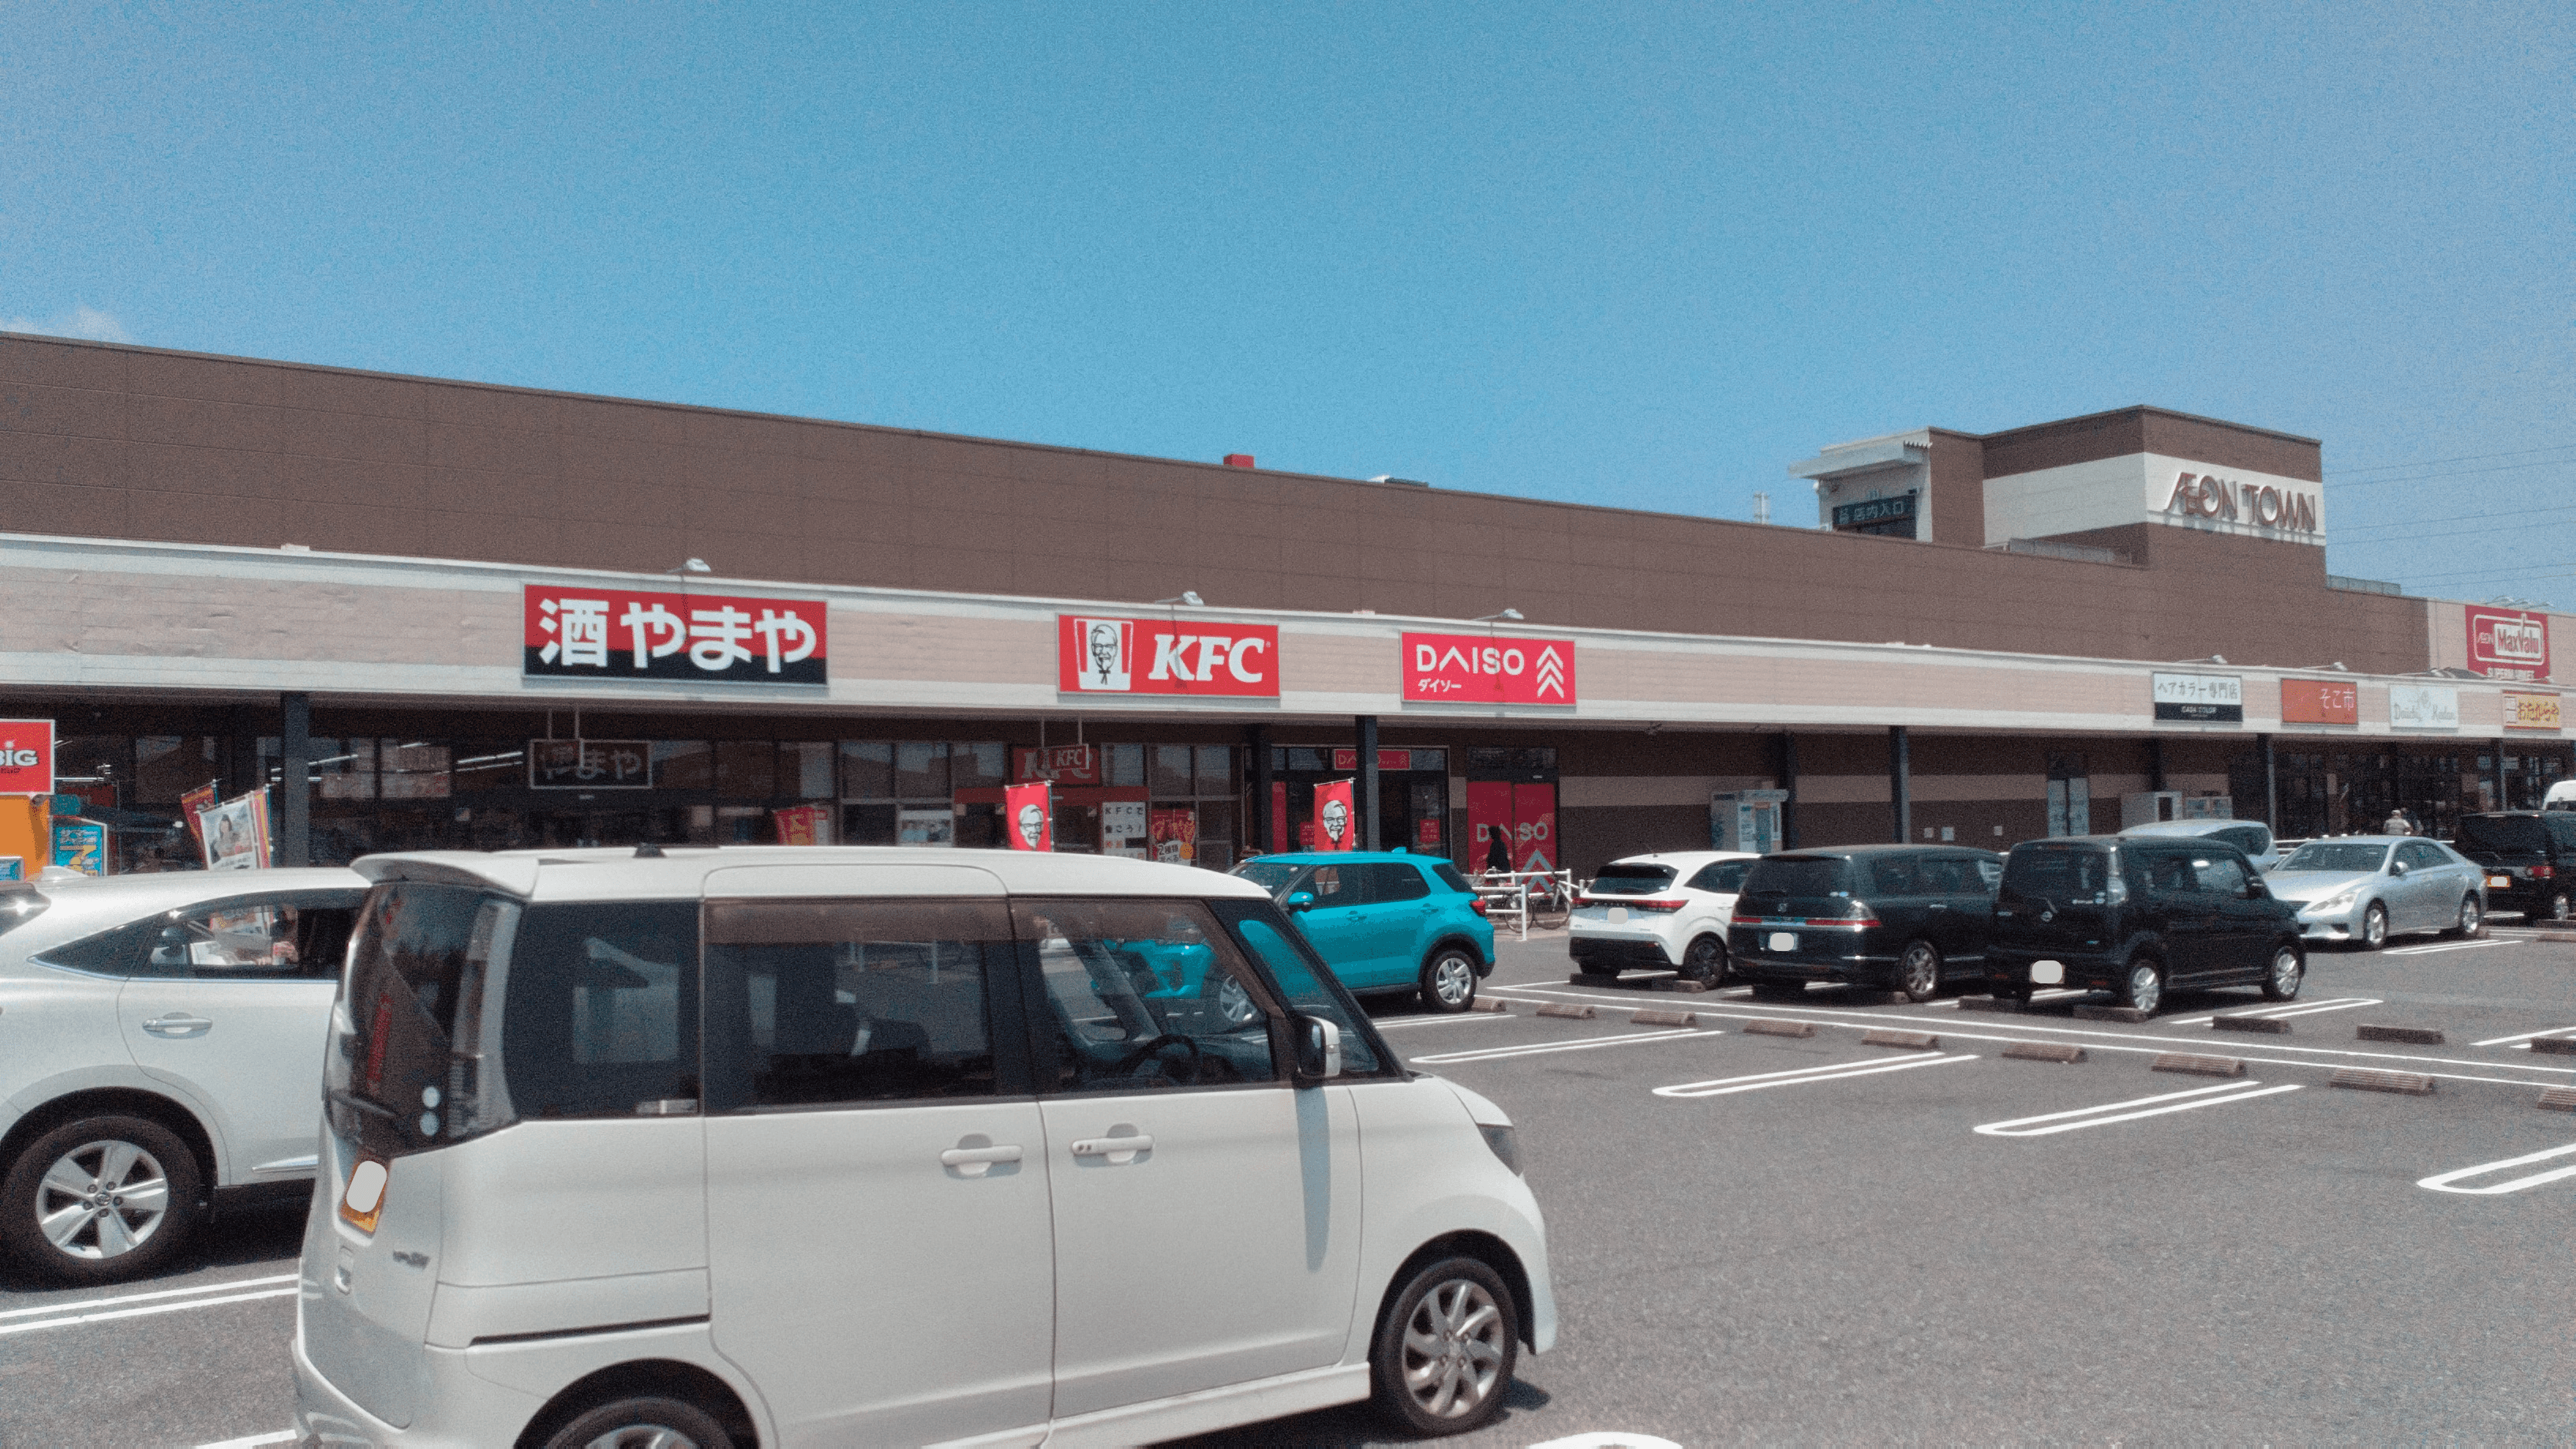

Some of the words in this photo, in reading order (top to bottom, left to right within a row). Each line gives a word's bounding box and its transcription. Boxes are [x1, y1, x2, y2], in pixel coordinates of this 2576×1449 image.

[1853, 500, 1904, 522] 店内入口
[2241, 484, 2316, 534] TOWN
[2497, 627, 2540, 654] MaxValu
[1148, 634, 1264, 683] KFC
[1416, 644, 1525, 676] DAISO
[1417, 678, 1462, 693] ダイソー
[2157, 681, 2238, 699] ヘアカラー専門店
[1056, 748, 1082, 766] KFC
